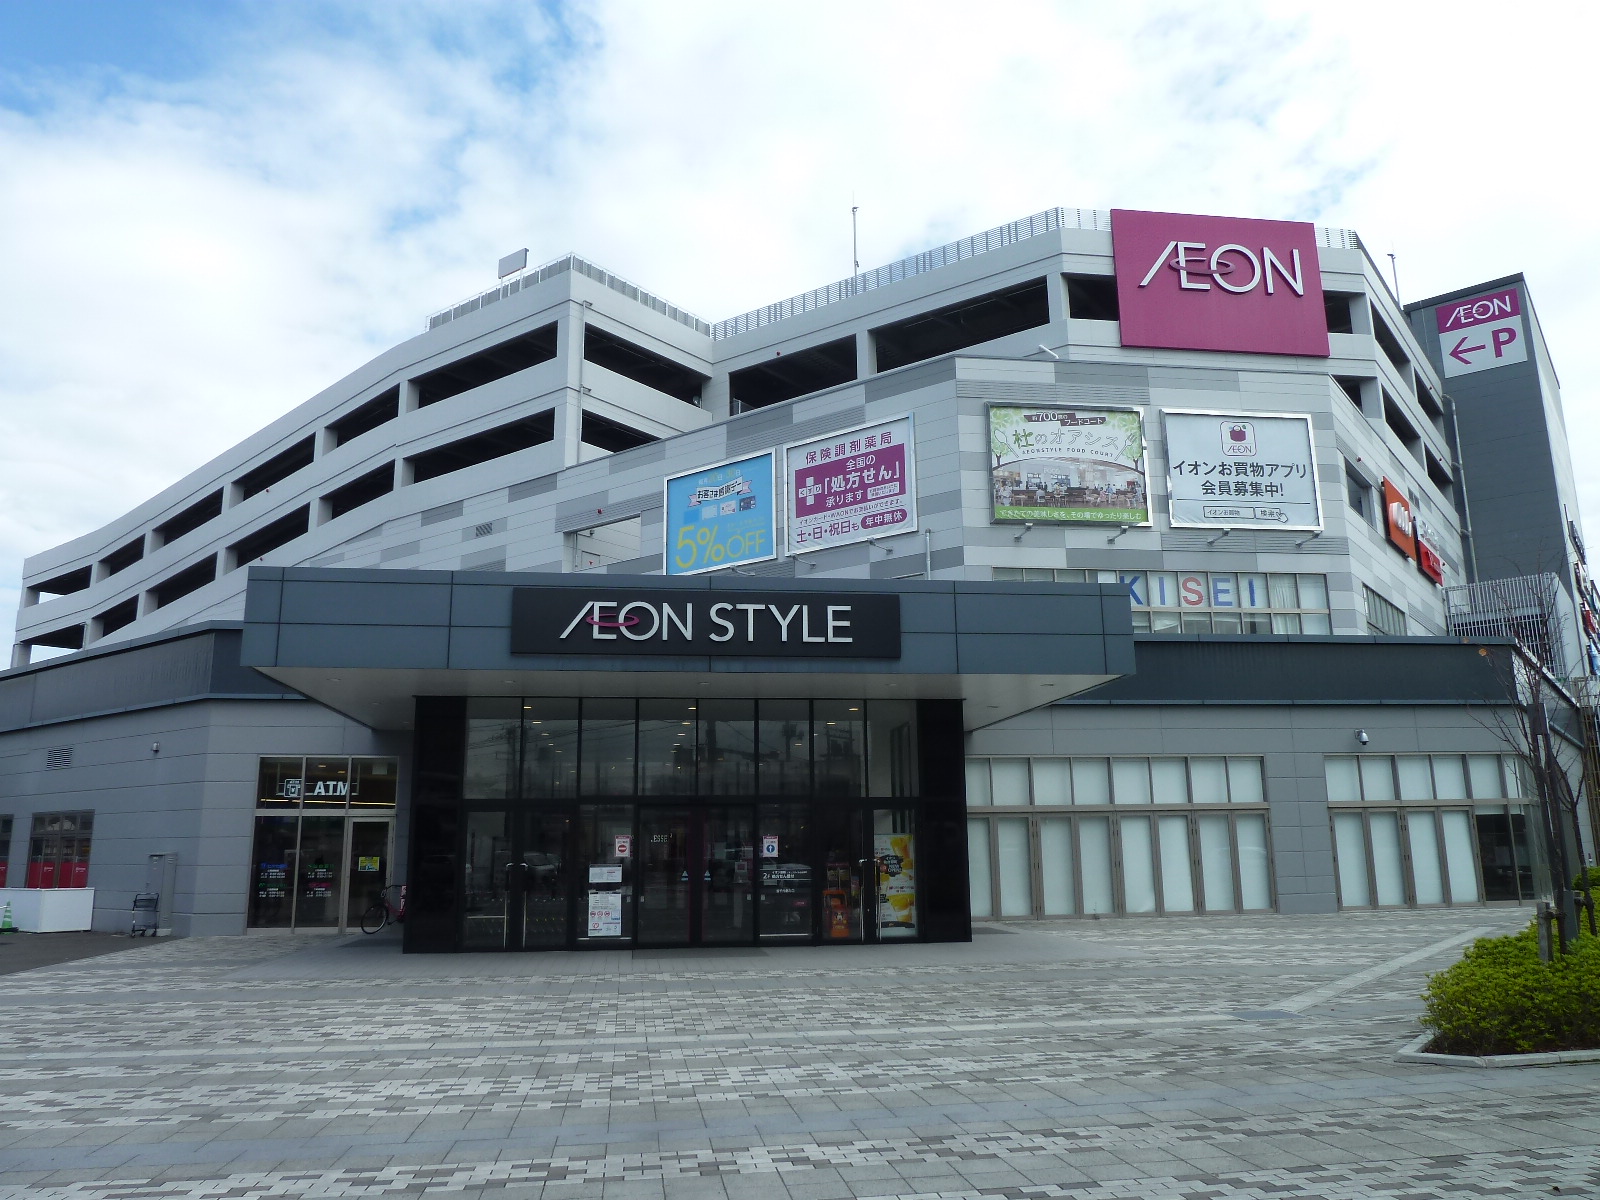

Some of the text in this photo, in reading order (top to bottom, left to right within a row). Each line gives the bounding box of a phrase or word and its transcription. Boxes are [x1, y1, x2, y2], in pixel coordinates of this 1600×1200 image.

[1491, 327, 1517, 358] P
[1065, 418, 1103, 426] フードコート
[1013, 428, 1119, 449] 杜のオアシス
[805, 431, 892, 465] 保険調剤薬局
[1090, 449, 1114, 458] COURT
[846, 454, 876, 471] 全国の
[1173, 460, 1307, 479] イオンお買物アプリ
[824, 461, 900, 494] 「処方せん」
[800, 485, 821, 497] くすり
[826, 489, 864, 507] 承ります
[865, 511, 903, 526] 年中無休
[1207, 509, 1240, 517] イオンお買物
[1260, 510, 1276, 518] 検索
[709, 603, 853, 643] STYLE
[313, 781, 348, 796] ATM
